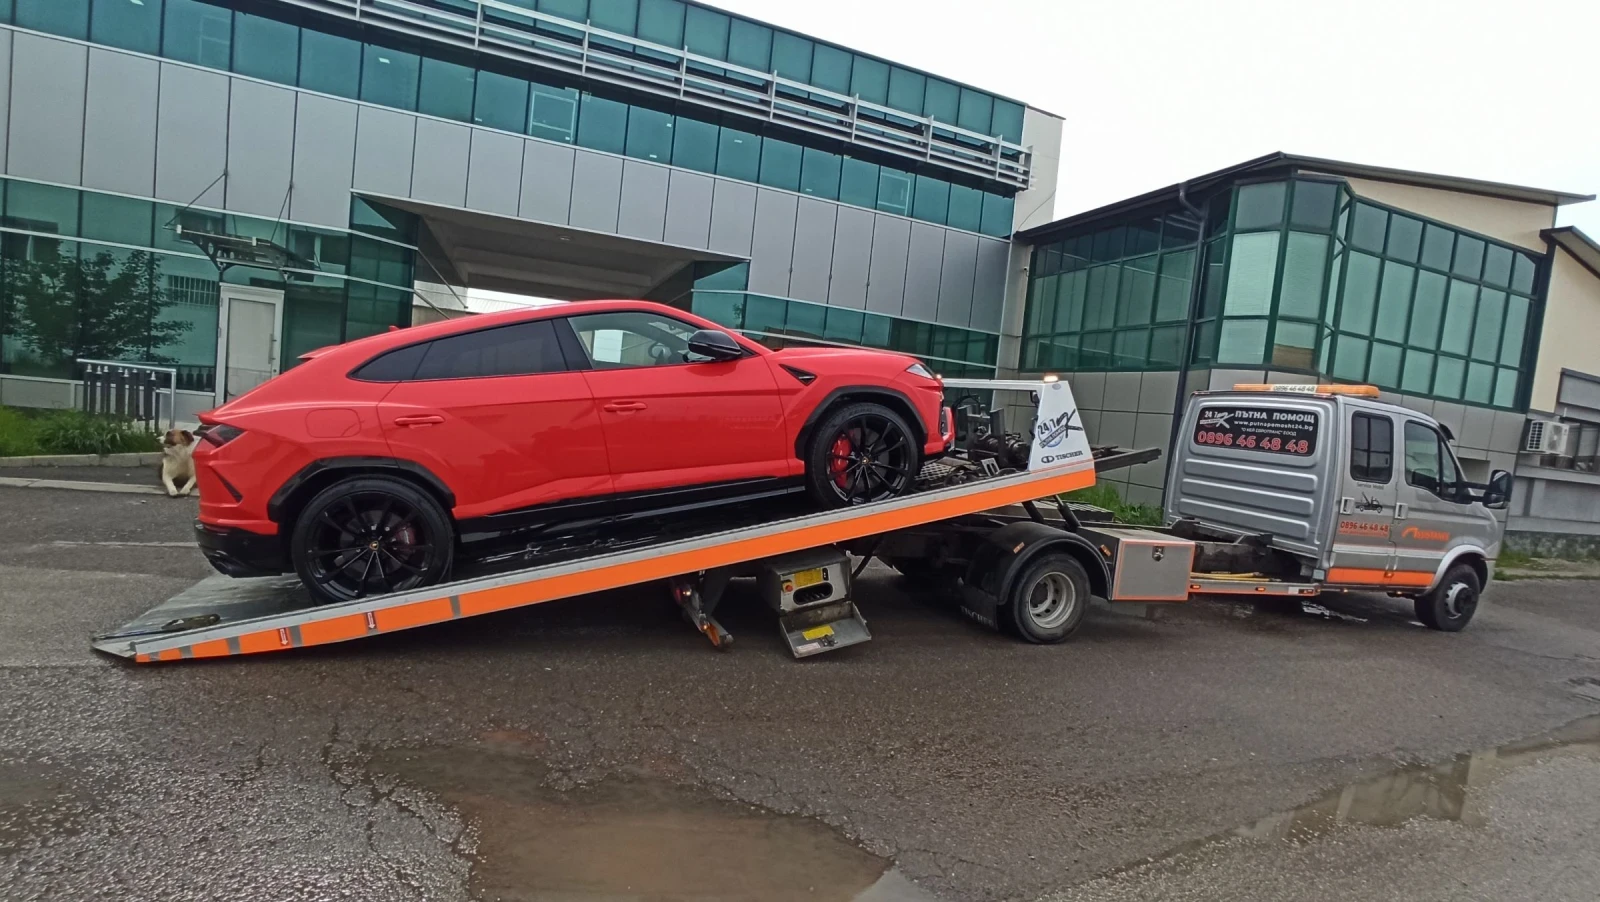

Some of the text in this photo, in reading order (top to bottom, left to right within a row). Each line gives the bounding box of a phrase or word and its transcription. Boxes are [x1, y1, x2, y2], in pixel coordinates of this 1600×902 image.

[1235, 410, 1315, 424] ПЪТНА ПОМОЩ
[1197, 430, 1309, 454] 0896 46 48 48
[1055, 450, 1083, 460] TISCHER
[1340, 521, 1358, 530] 0896
[1359, 522, 1368, 531] 46
[1369, 522, 1378, 532] 48
[1380, 523, 1389, 533] 48
